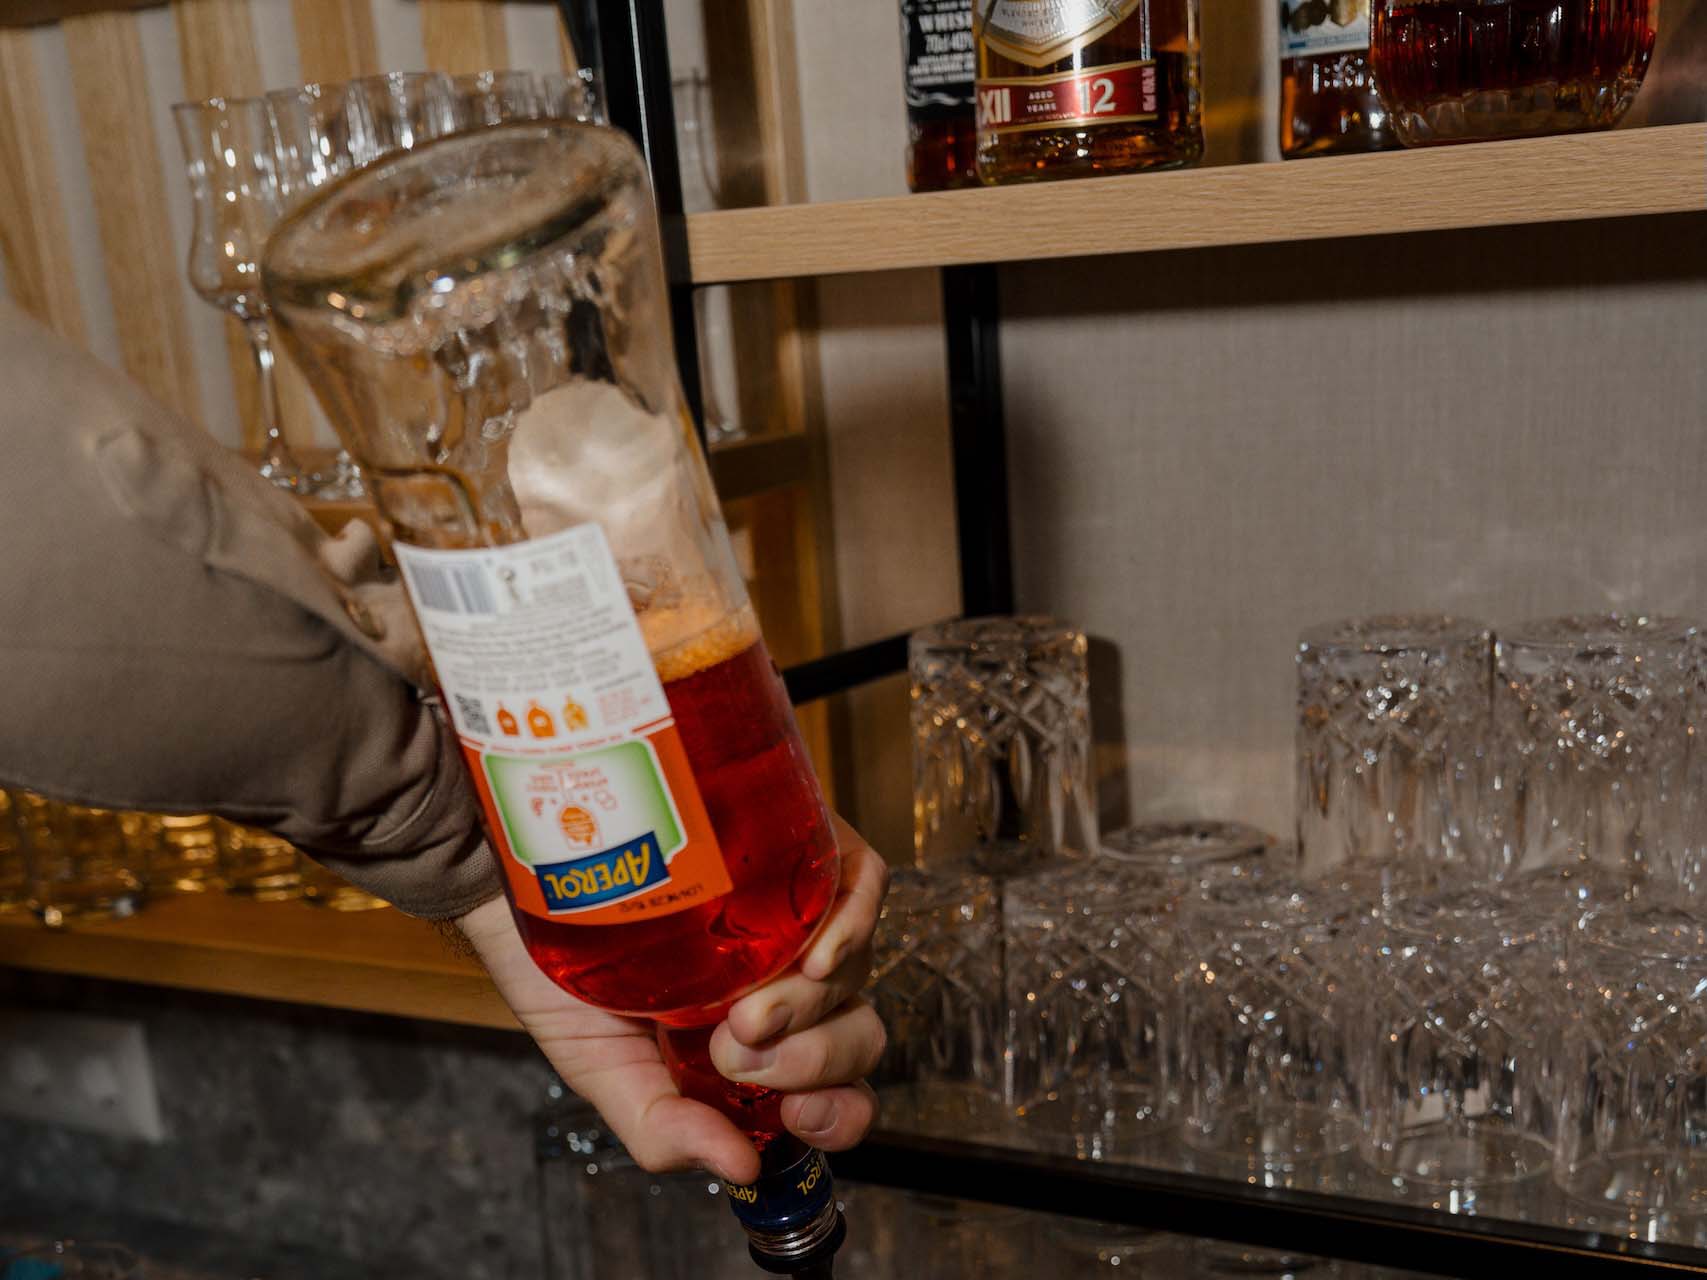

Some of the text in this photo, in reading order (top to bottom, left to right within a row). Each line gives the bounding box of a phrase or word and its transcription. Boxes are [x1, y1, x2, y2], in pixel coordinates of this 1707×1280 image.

[1028, 90, 1054, 100] AGED
[1079, 78, 1117, 114] 12
[1026, 103, 1057, 113] YEARS
[544, 842, 651, 900] APEROL
